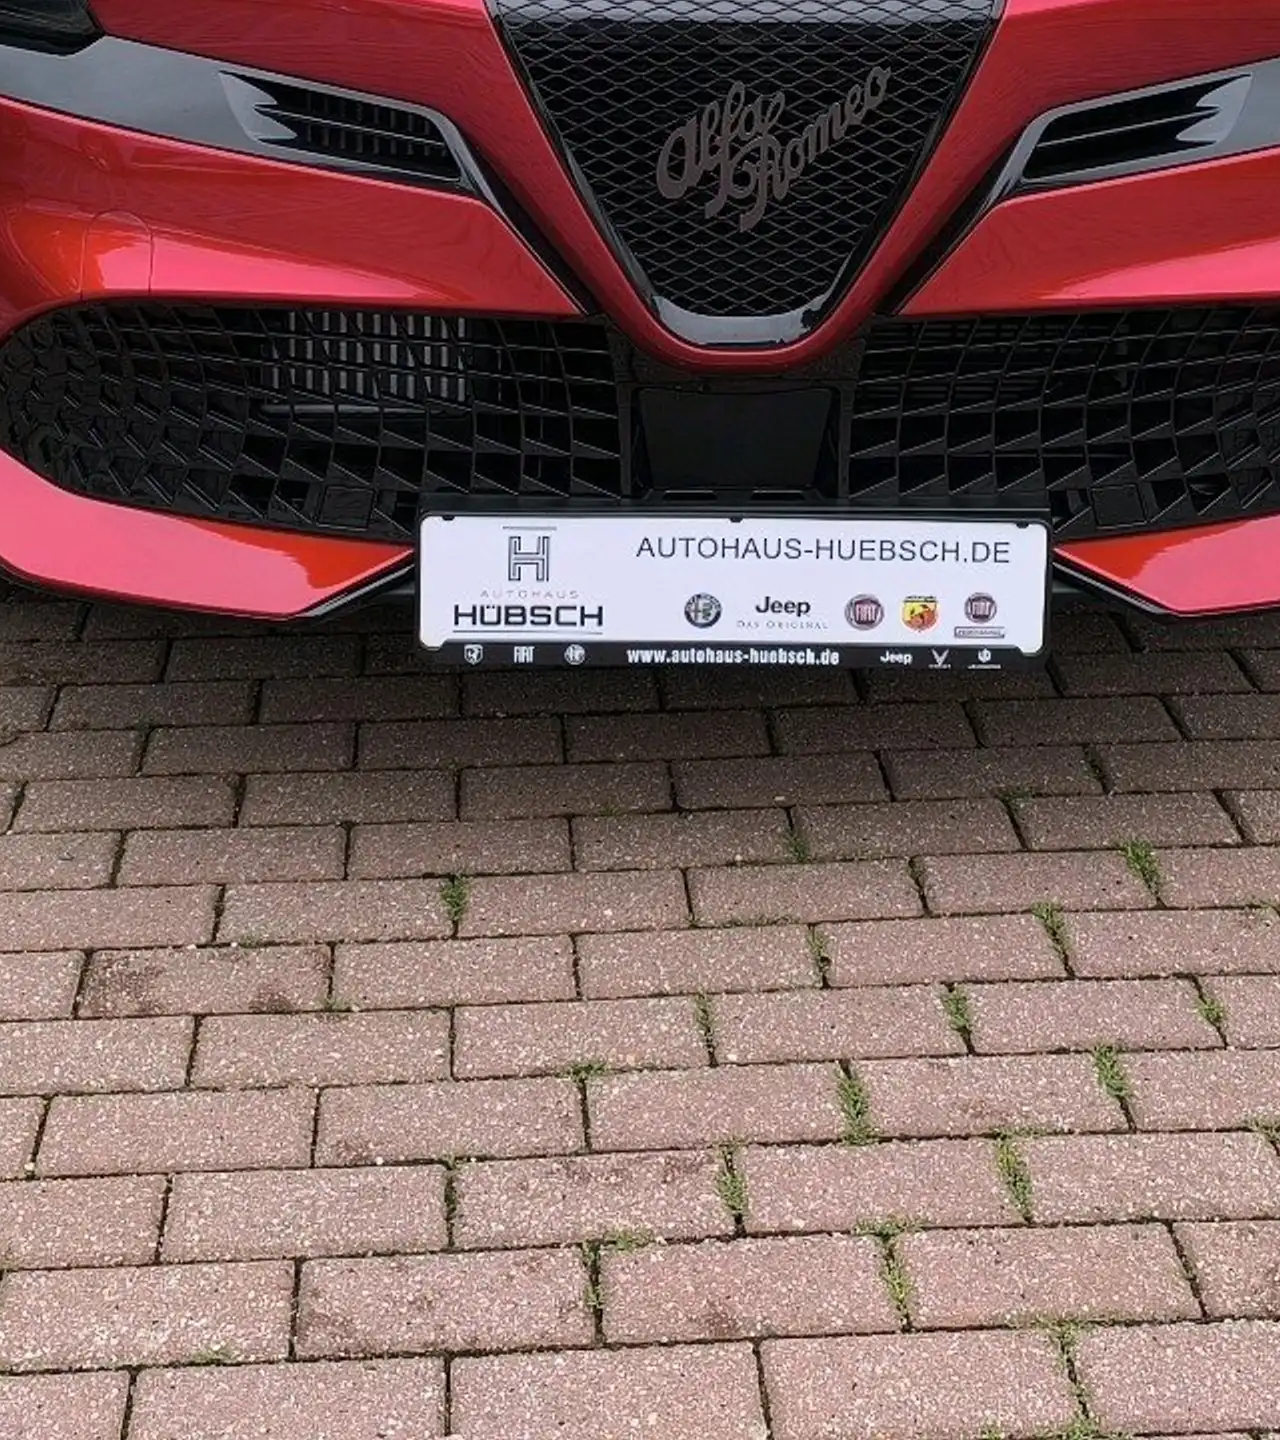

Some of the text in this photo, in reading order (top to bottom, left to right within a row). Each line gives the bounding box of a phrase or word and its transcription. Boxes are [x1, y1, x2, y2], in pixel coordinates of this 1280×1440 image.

[656, 65, 892, 232] Alfa Romeo
[635, 536, 1012, 564] AUTOHAUS-HUEBSCH.DE
[479, 590, 580, 599] AUTOHAUS
[453, 604, 604, 627] HÜBSCH
[755, 596, 811, 617] Jeep
[627, 646, 840, 667] www.autohaus-huebsch.de
[880, 650, 914, 666] Jeep
